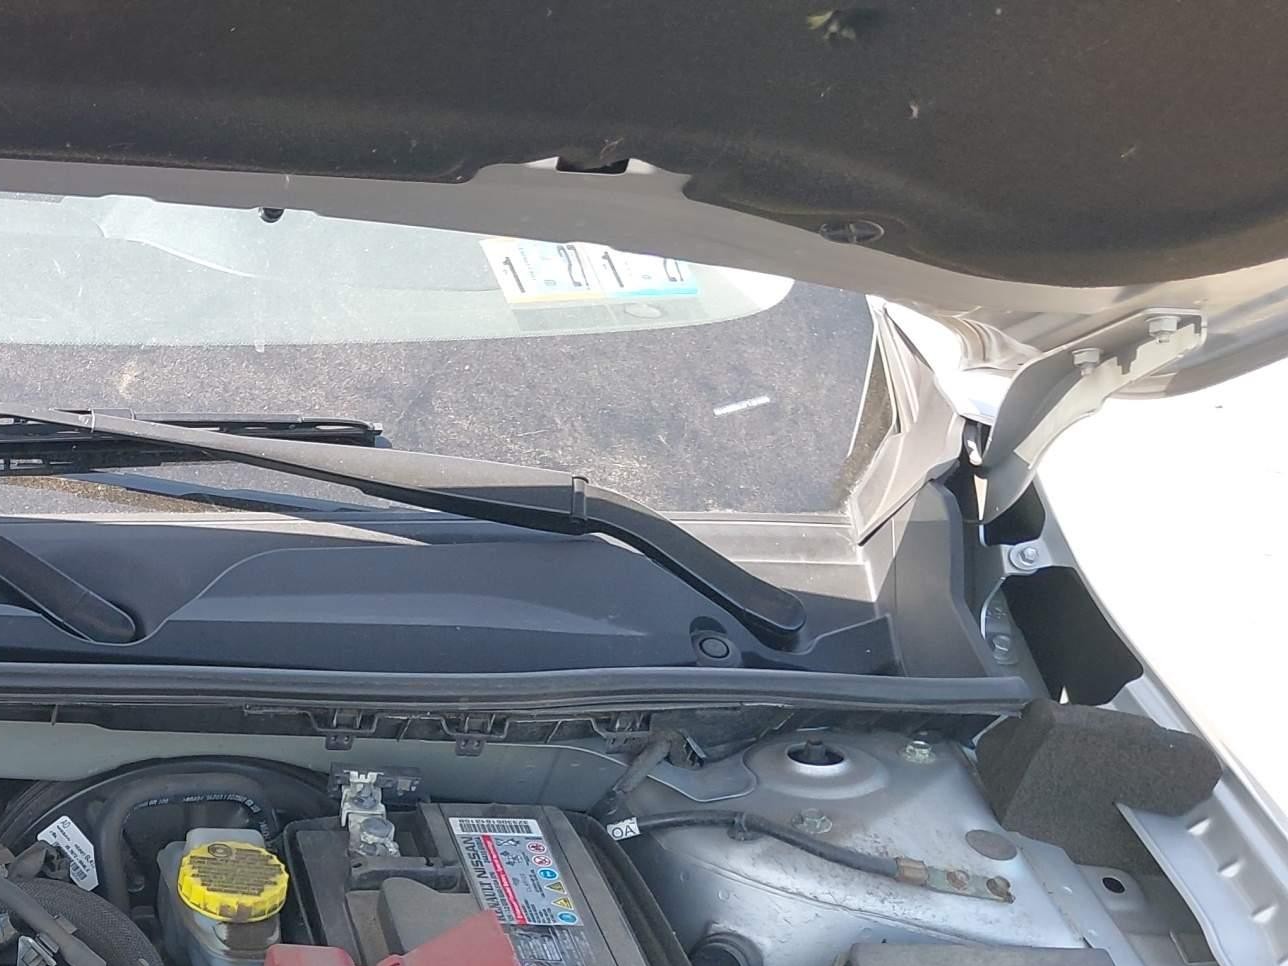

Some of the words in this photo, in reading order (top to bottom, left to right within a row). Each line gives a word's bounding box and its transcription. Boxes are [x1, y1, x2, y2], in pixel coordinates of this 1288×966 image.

[503, 256, 526, 293] 1
[601, 251, 624, 289] 1
[462, 836, 487, 879] NISSAN
